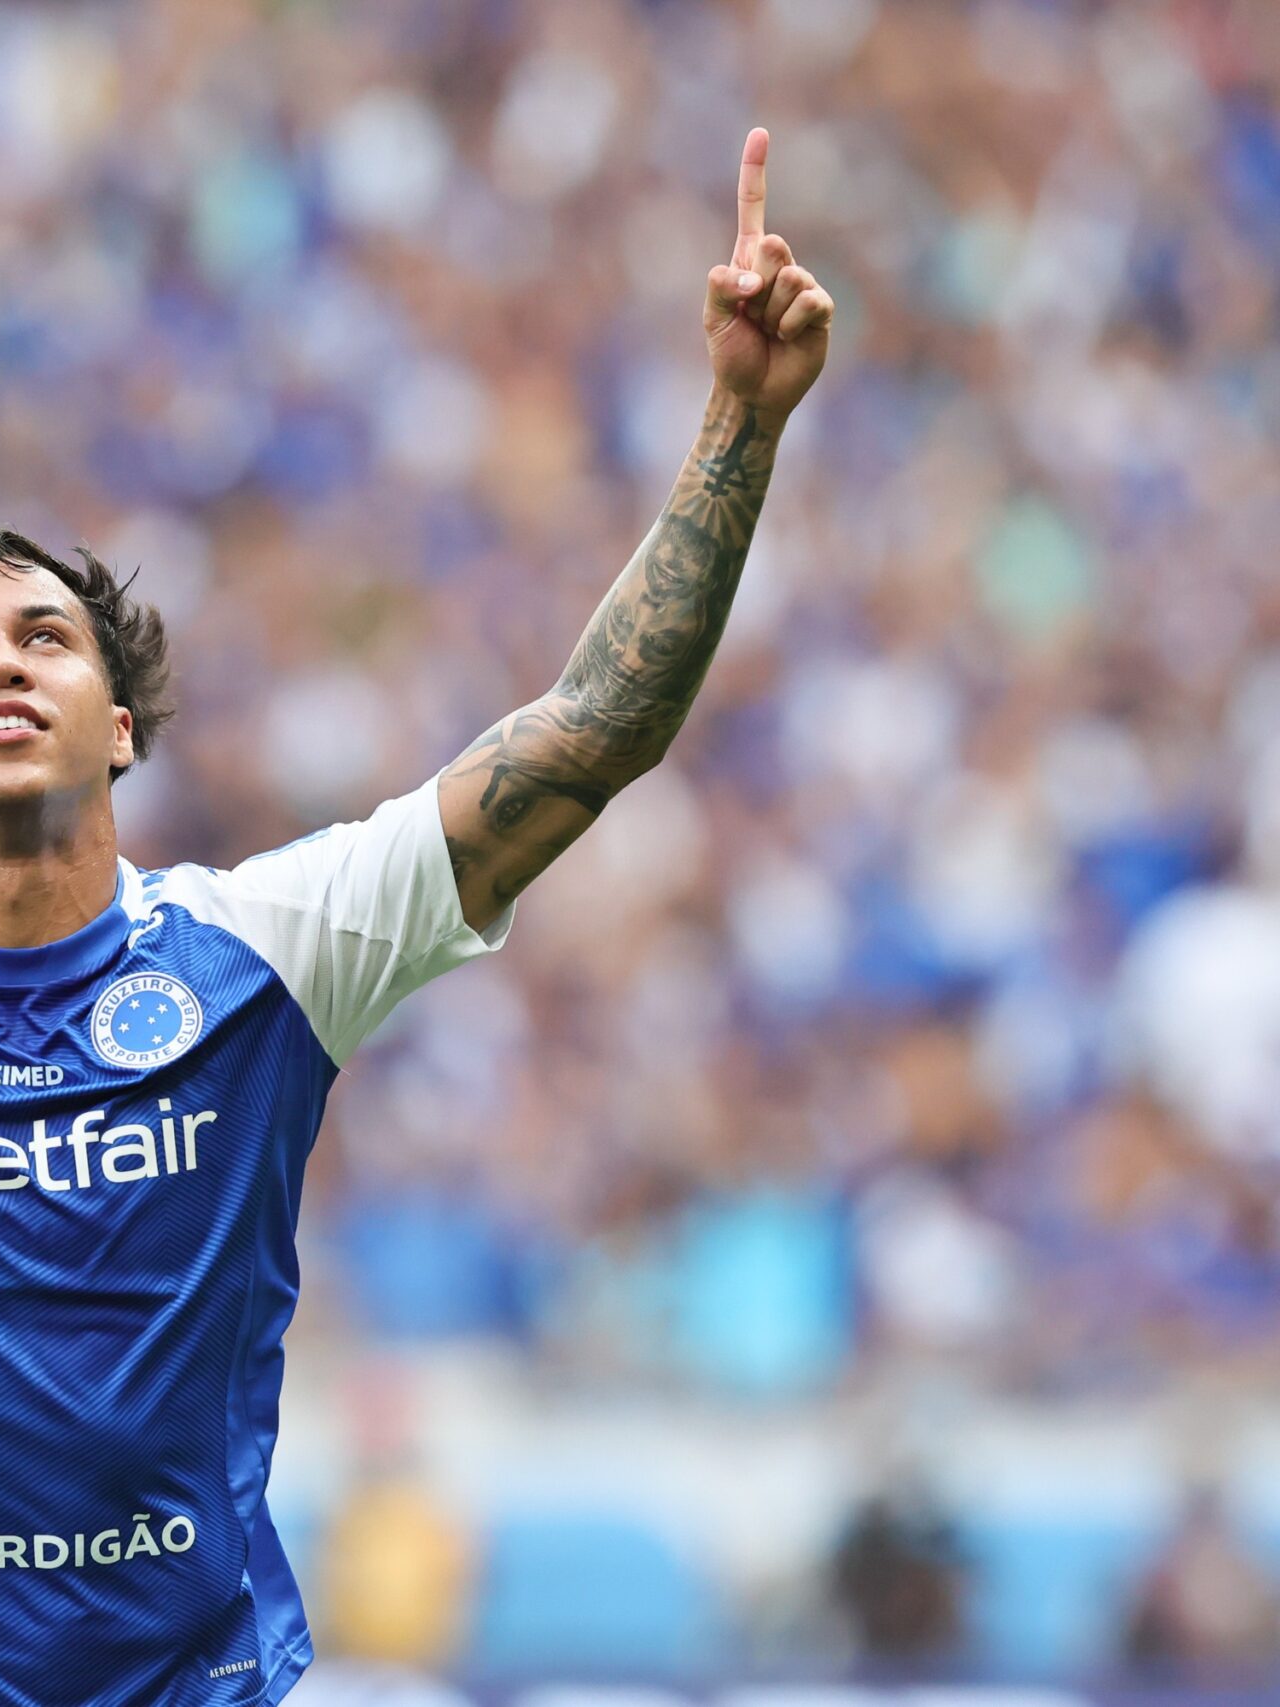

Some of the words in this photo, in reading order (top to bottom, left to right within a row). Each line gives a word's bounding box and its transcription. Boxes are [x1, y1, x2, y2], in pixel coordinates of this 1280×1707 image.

[98, 979, 173, 1027] CRUZEIRO
[100, 1035, 174, 1062] ESPORTE
[177, 996, 196, 1045] CLUBE
[209, 1659, 257, 1679] AEROREADY
